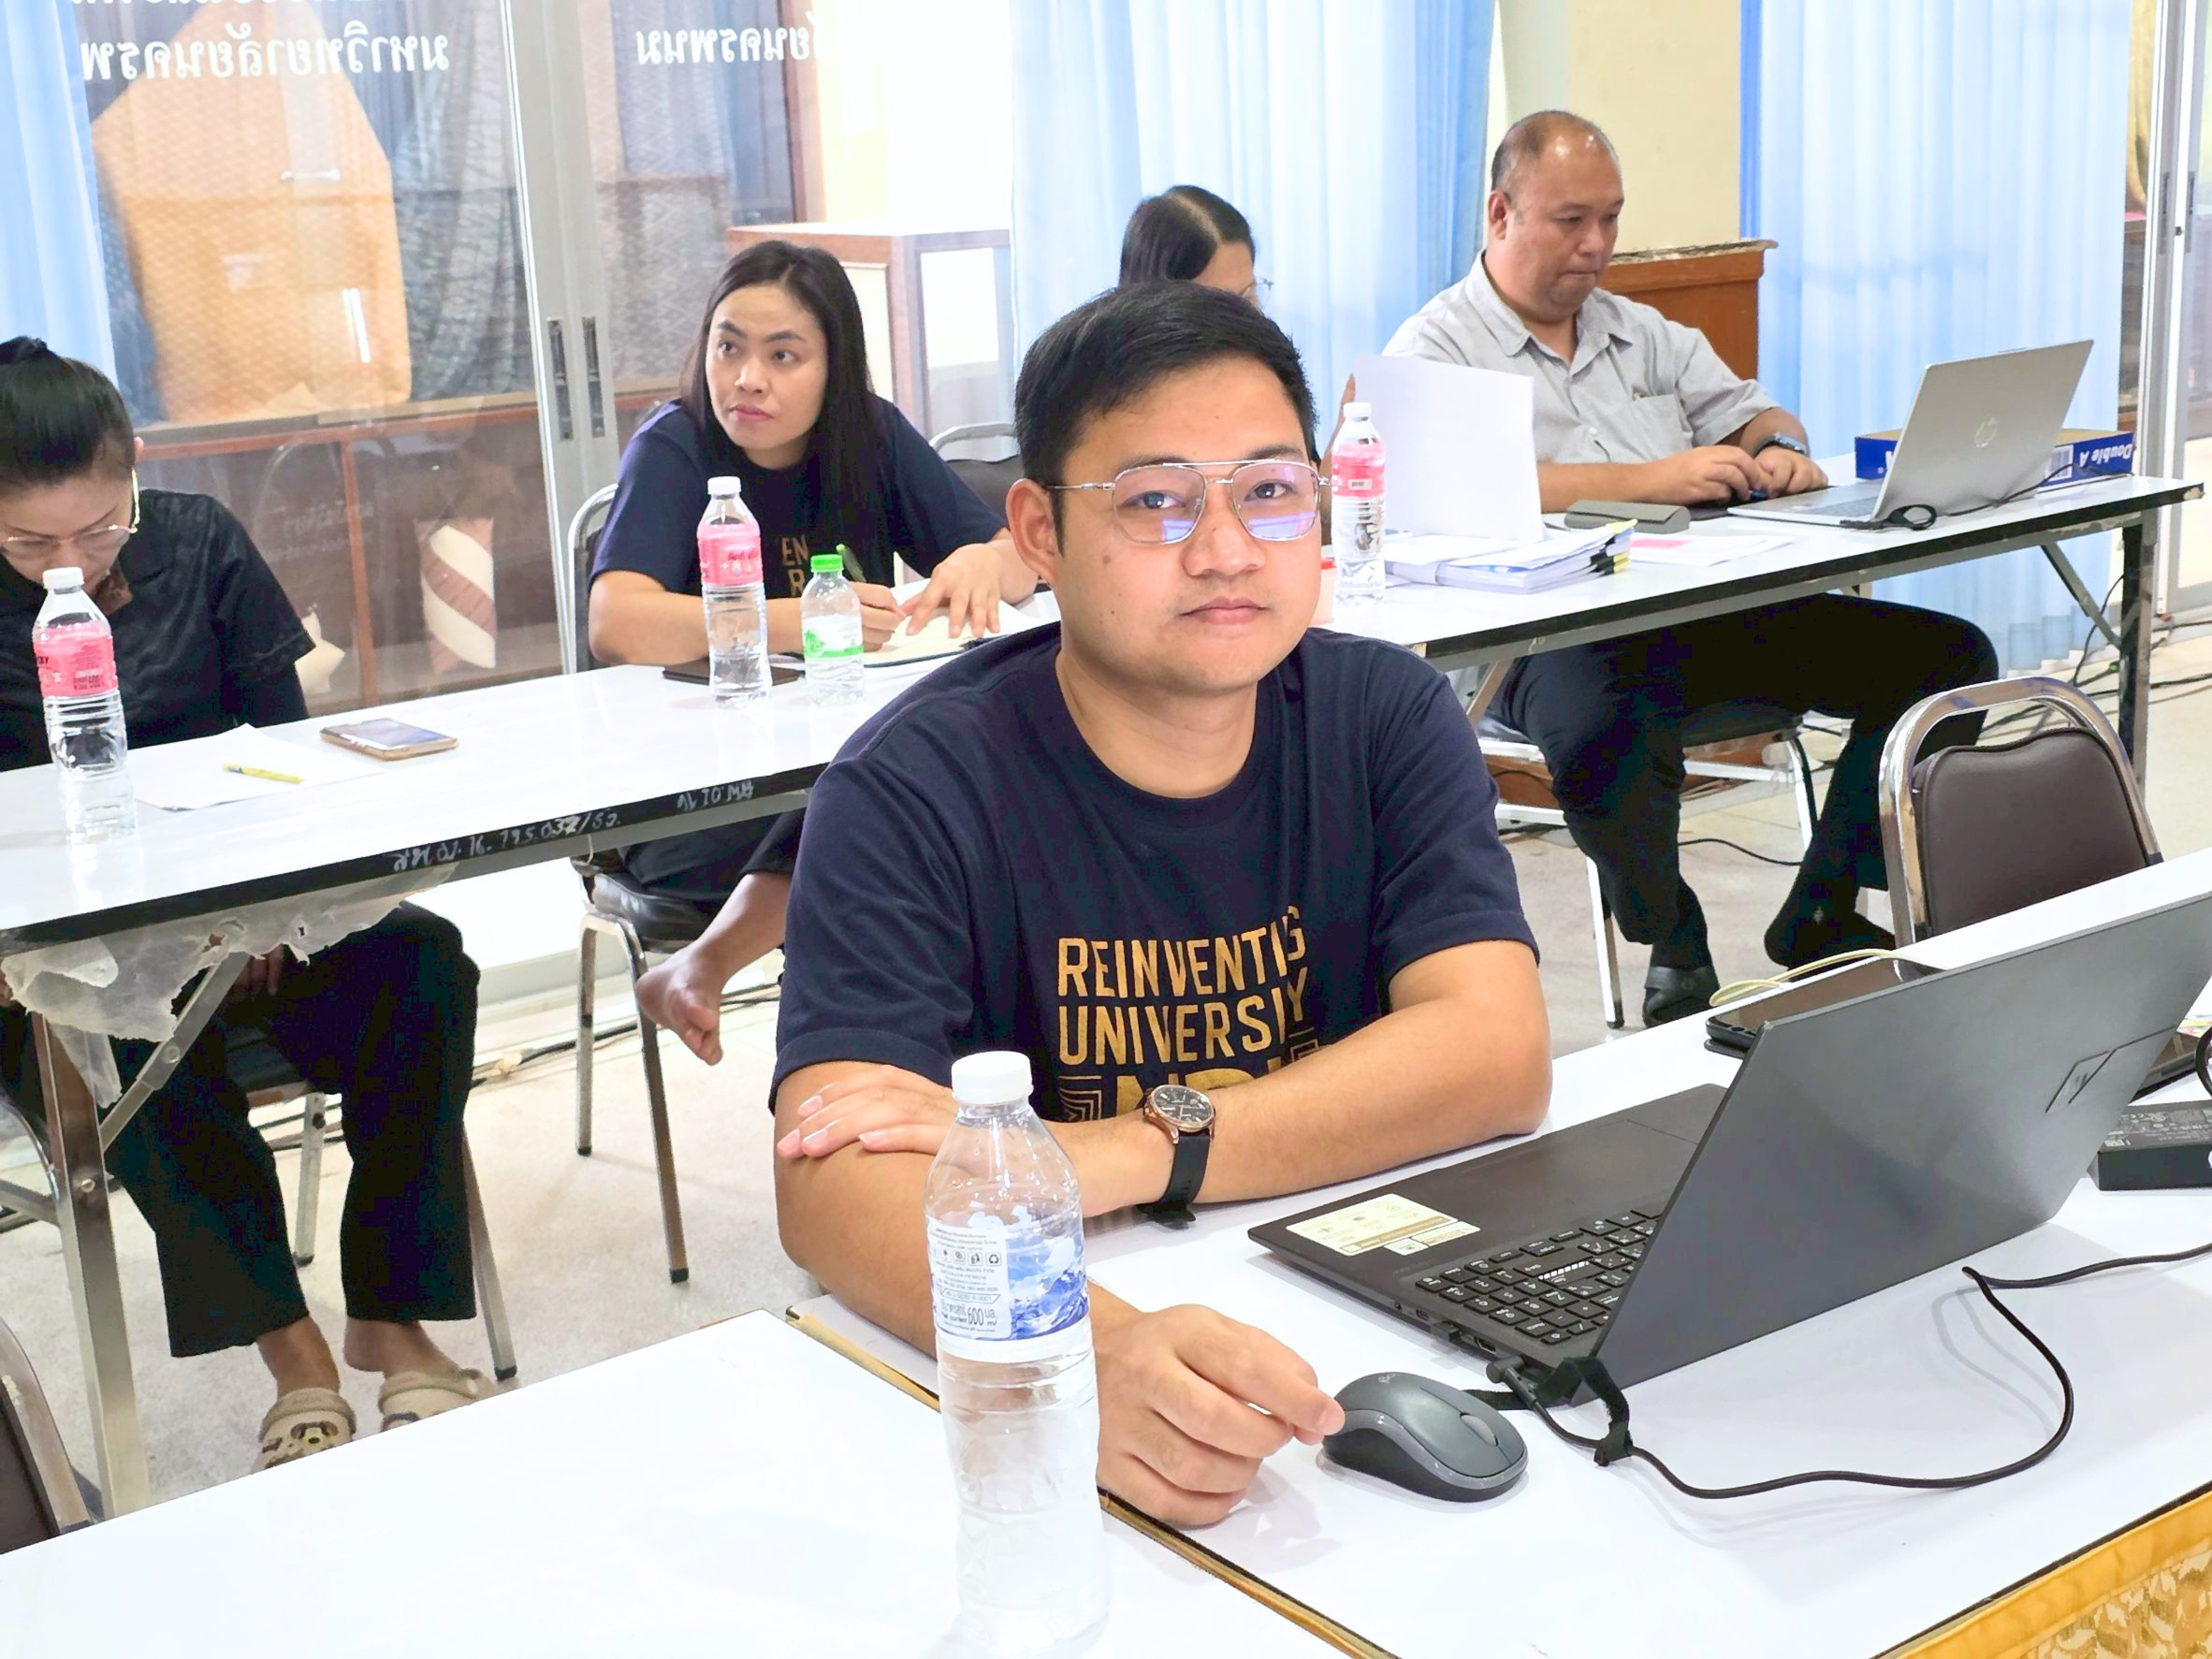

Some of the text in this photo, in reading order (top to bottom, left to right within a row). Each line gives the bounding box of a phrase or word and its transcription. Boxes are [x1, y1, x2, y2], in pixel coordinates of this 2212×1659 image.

[2080, 444, 2133, 468] Double A
[1058, 905, 1306, 998] REINVENTIG
[1058, 966, 1308, 1065] UNIVERSIY
[967, 1307, 984, 1326] 600
